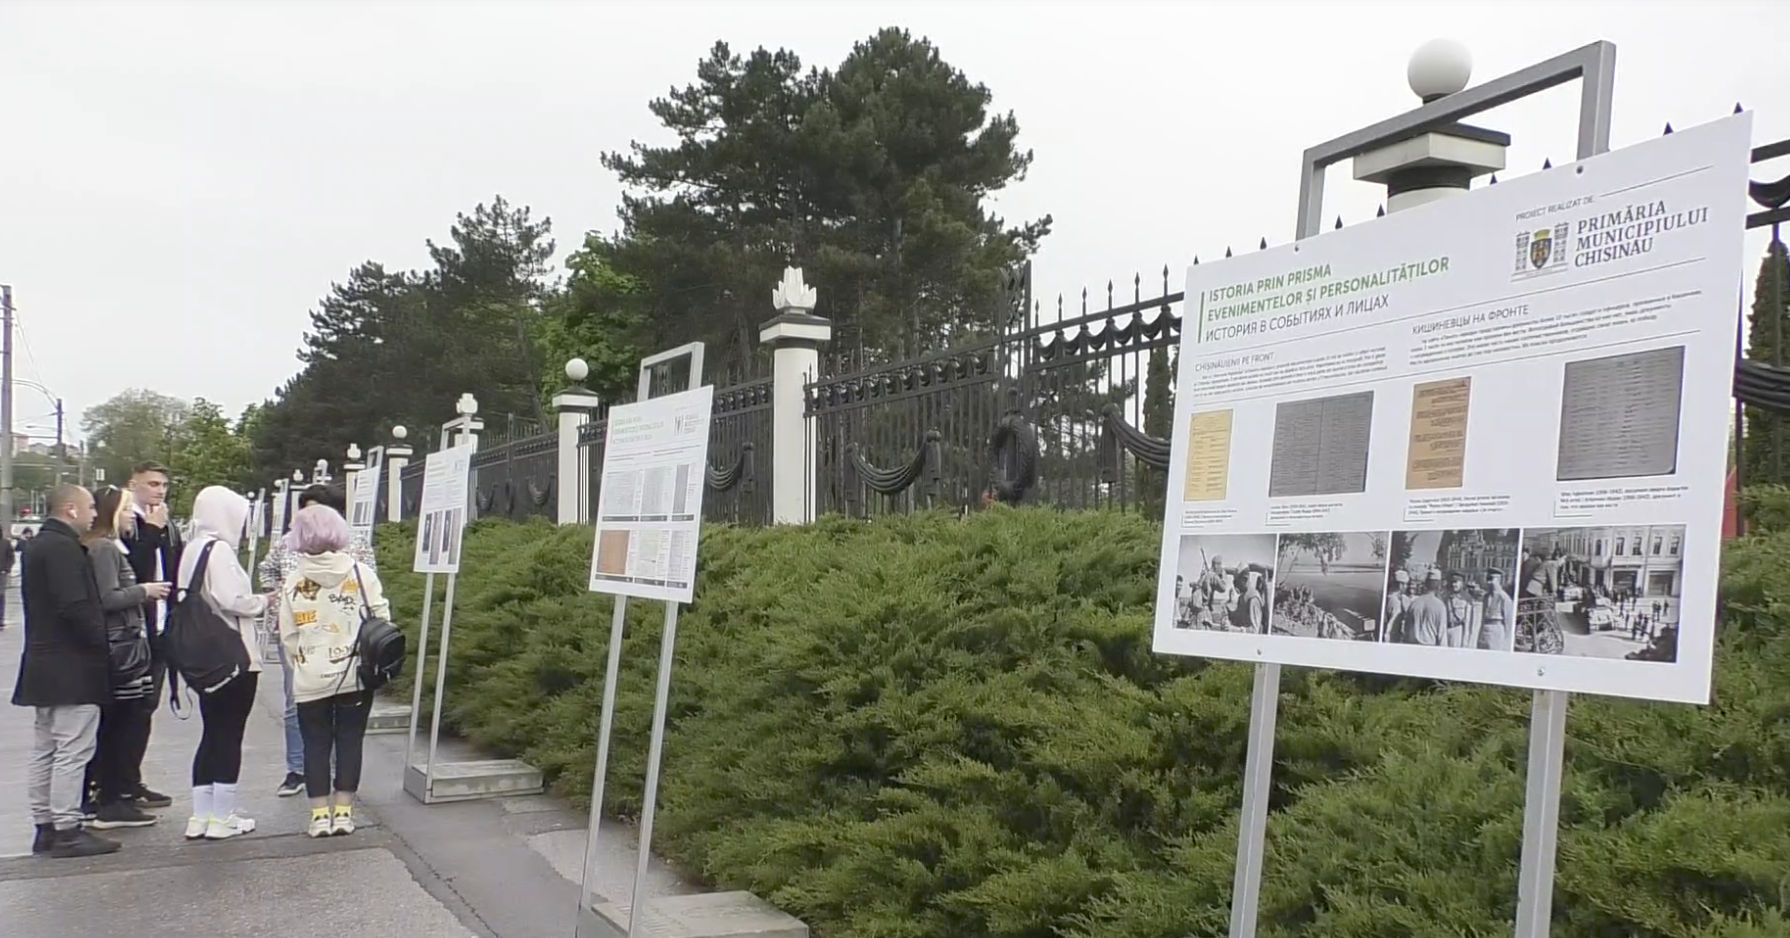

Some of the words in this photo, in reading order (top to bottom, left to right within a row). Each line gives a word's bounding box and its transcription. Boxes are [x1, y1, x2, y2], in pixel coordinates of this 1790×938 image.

[1576, 206, 1708, 251] MUNICIPIULUI
[1577, 199, 1665, 234] PRIMĂRIA
[1209, 281, 1254, 303] ISTORIA
[1257, 274, 1285, 294] PRIN
[1288, 263, 1331, 286] PRISMA
[1206, 321, 1257, 342] ИСТОРИЯ
[1269, 306, 1332, 331] СОБЫТИЯХ
[1335, 303, 1344, 317] И
[1346, 293, 1389, 316] ЛИЦАХ
[1208, 292, 1303, 322] EVENIMENTELOR
[1472, 312, 1486, 324] НА
[1488, 304, 1529, 320] ФРОНТЕ
